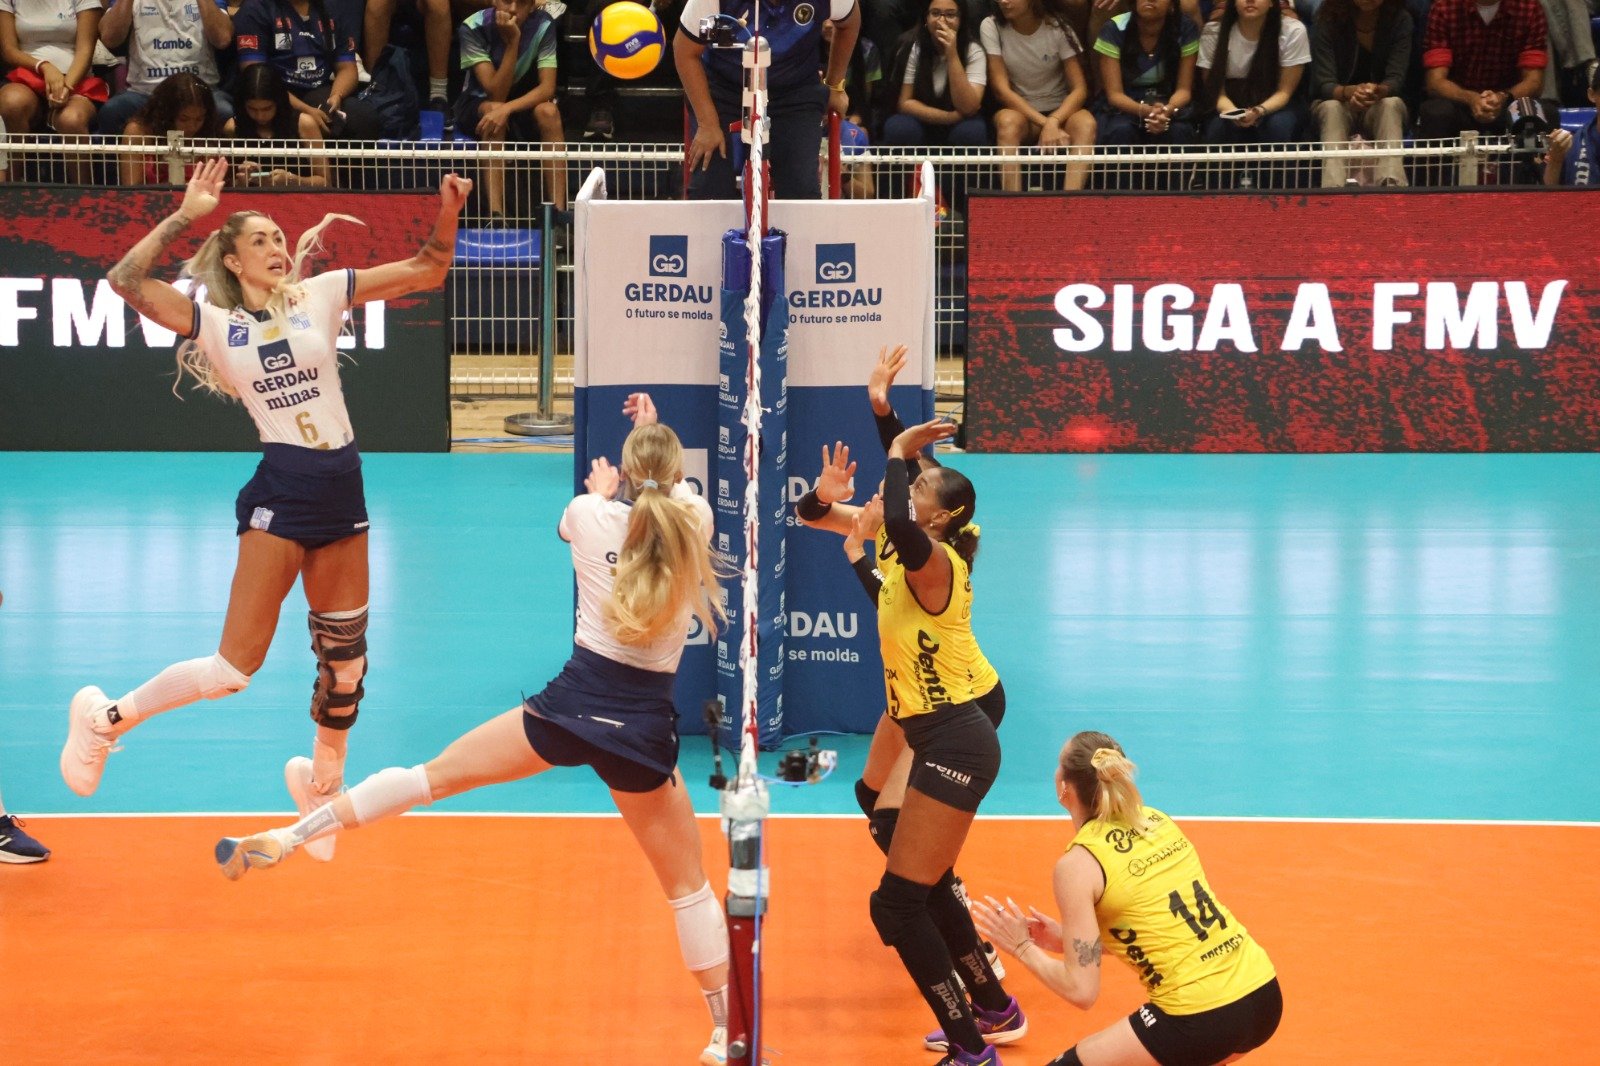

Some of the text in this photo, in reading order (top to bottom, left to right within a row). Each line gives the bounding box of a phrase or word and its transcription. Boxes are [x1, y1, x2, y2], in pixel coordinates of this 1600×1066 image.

[153, 38, 193, 50] Itambé
[624, 282, 713, 304] GERDAU
[788, 287, 883, 308] GERDAU
[625, 308, 713, 320] O futuro se molda
[789, 312, 882, 324] O futuro se molda
[1052, 279, 1569, 353] SIGA A FMV
[252, 367, 319, 394] GERDAU
[265, 386, 321, 411] minas
[294, 411, 319, 443] 6
[788, 648, 860, 663] se molda
[1167, 879, 1228, 943] 14
[960, 952, 988, 985] Dentil
[930, 982, 963, 1021] Dentil
